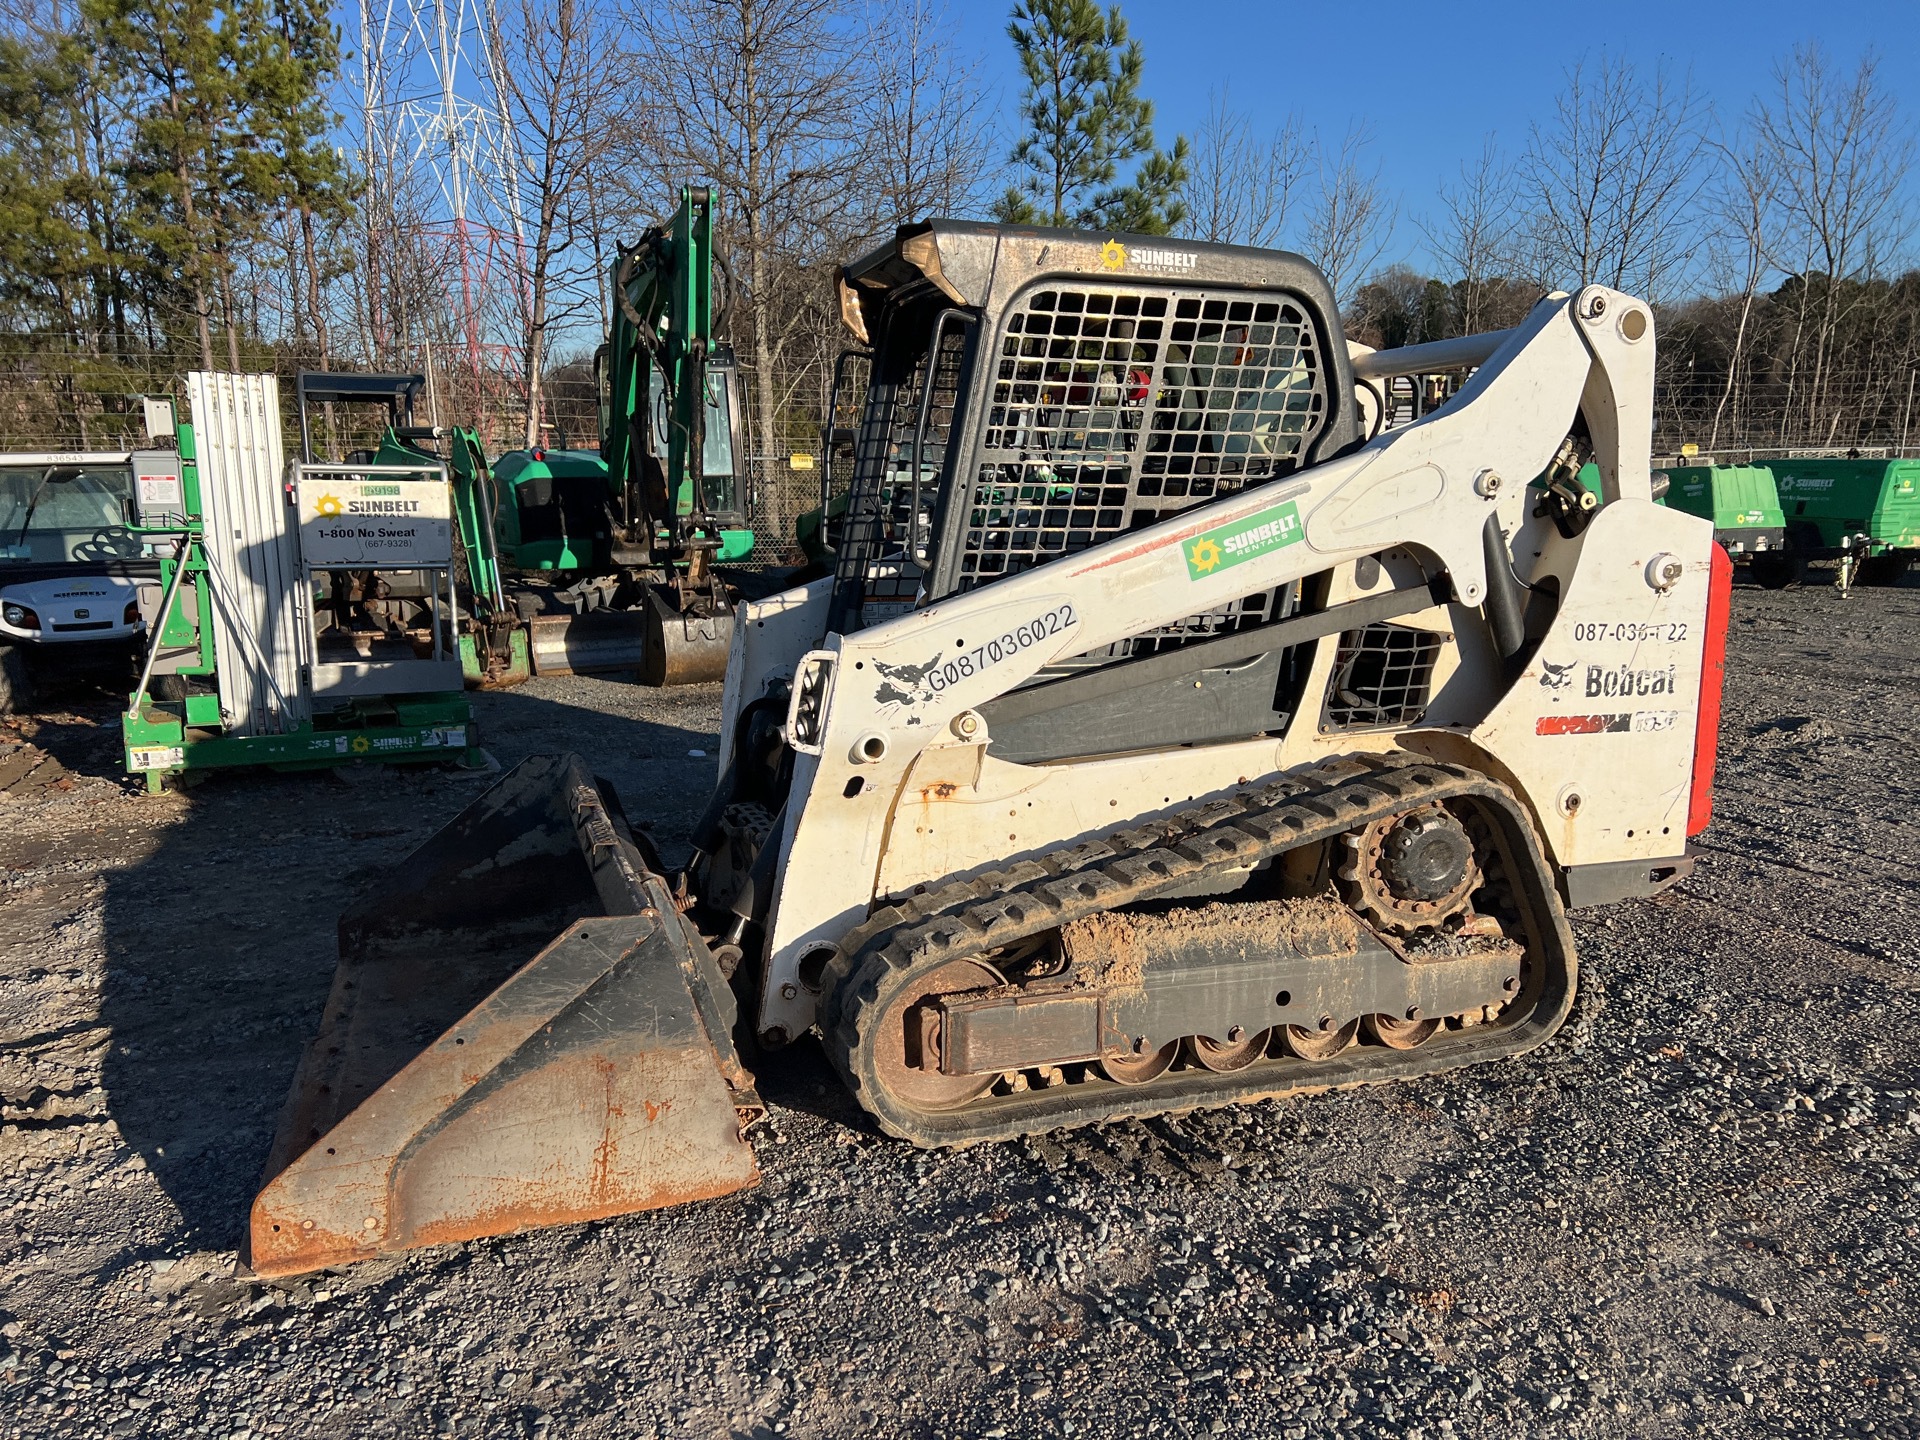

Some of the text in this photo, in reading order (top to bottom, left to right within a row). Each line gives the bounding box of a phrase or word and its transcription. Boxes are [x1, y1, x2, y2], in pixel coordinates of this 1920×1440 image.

[1130, 249, 1198, 268] SUNBELT
[1140, 264, 1188, 273] RENTALS
[348, 500, 419, 513] SUNBELT
[318, 527, 416, 539] 1-800 No Sweat
[1223, 514, 1295, 554] SUNBELT
[364, 539, 412, 548] (667-9328)
[1236, 532, 1279, 557] RENTALS
[927, 604, 1077, 692] G087036022
[1585, 664, 1676, 697] Bobcat
